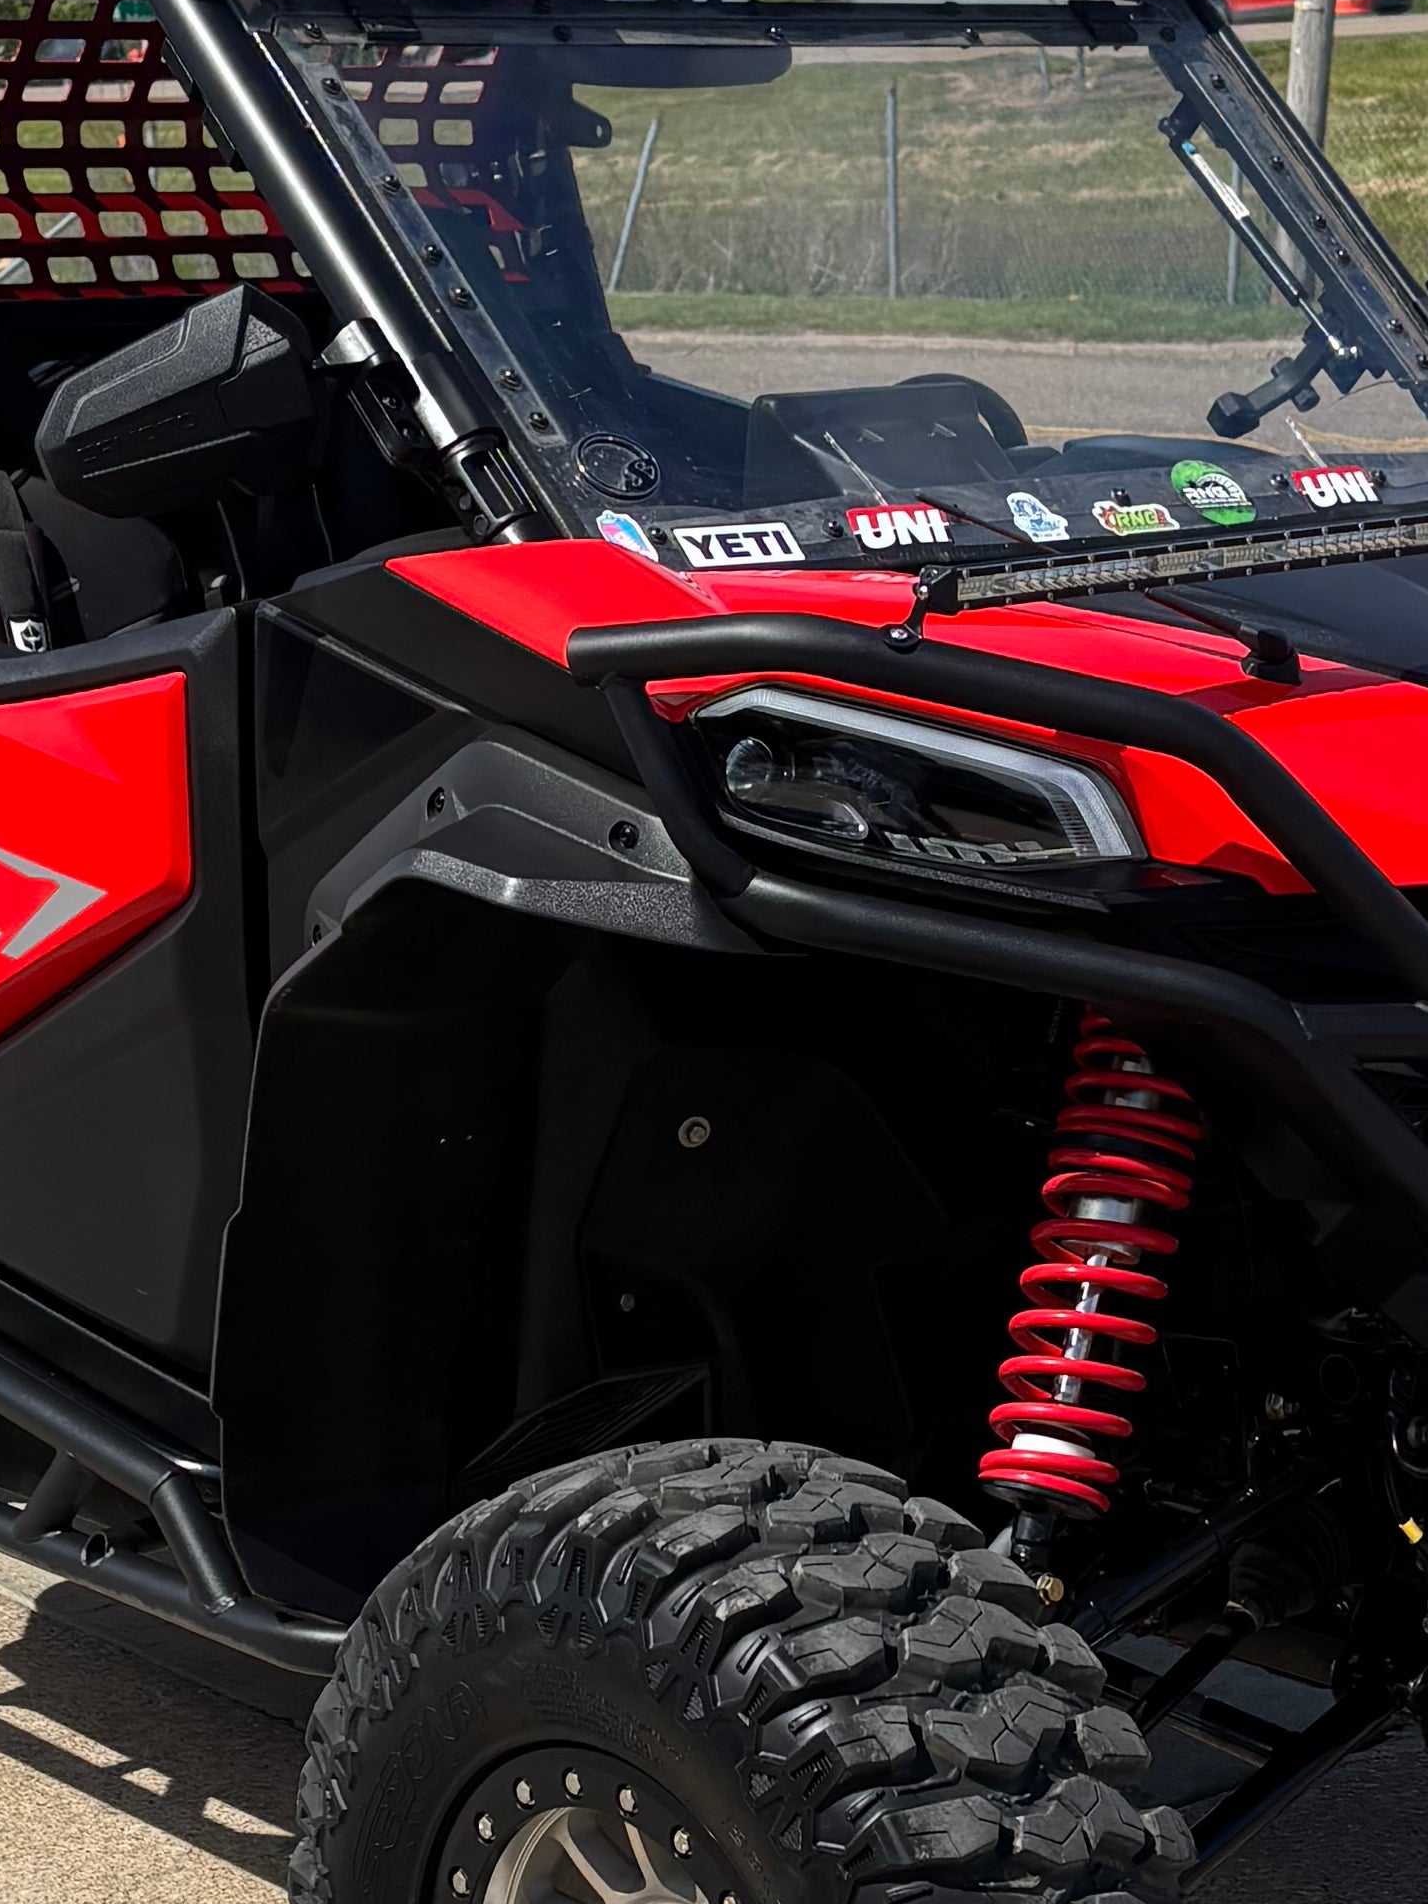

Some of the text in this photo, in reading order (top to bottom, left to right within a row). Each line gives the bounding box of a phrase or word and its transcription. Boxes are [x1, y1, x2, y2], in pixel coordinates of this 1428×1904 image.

[1300, 470, 1379, 508] UNI
[681, 529, 794, 560] YETI
[853, 507, 950, 550] UNI
